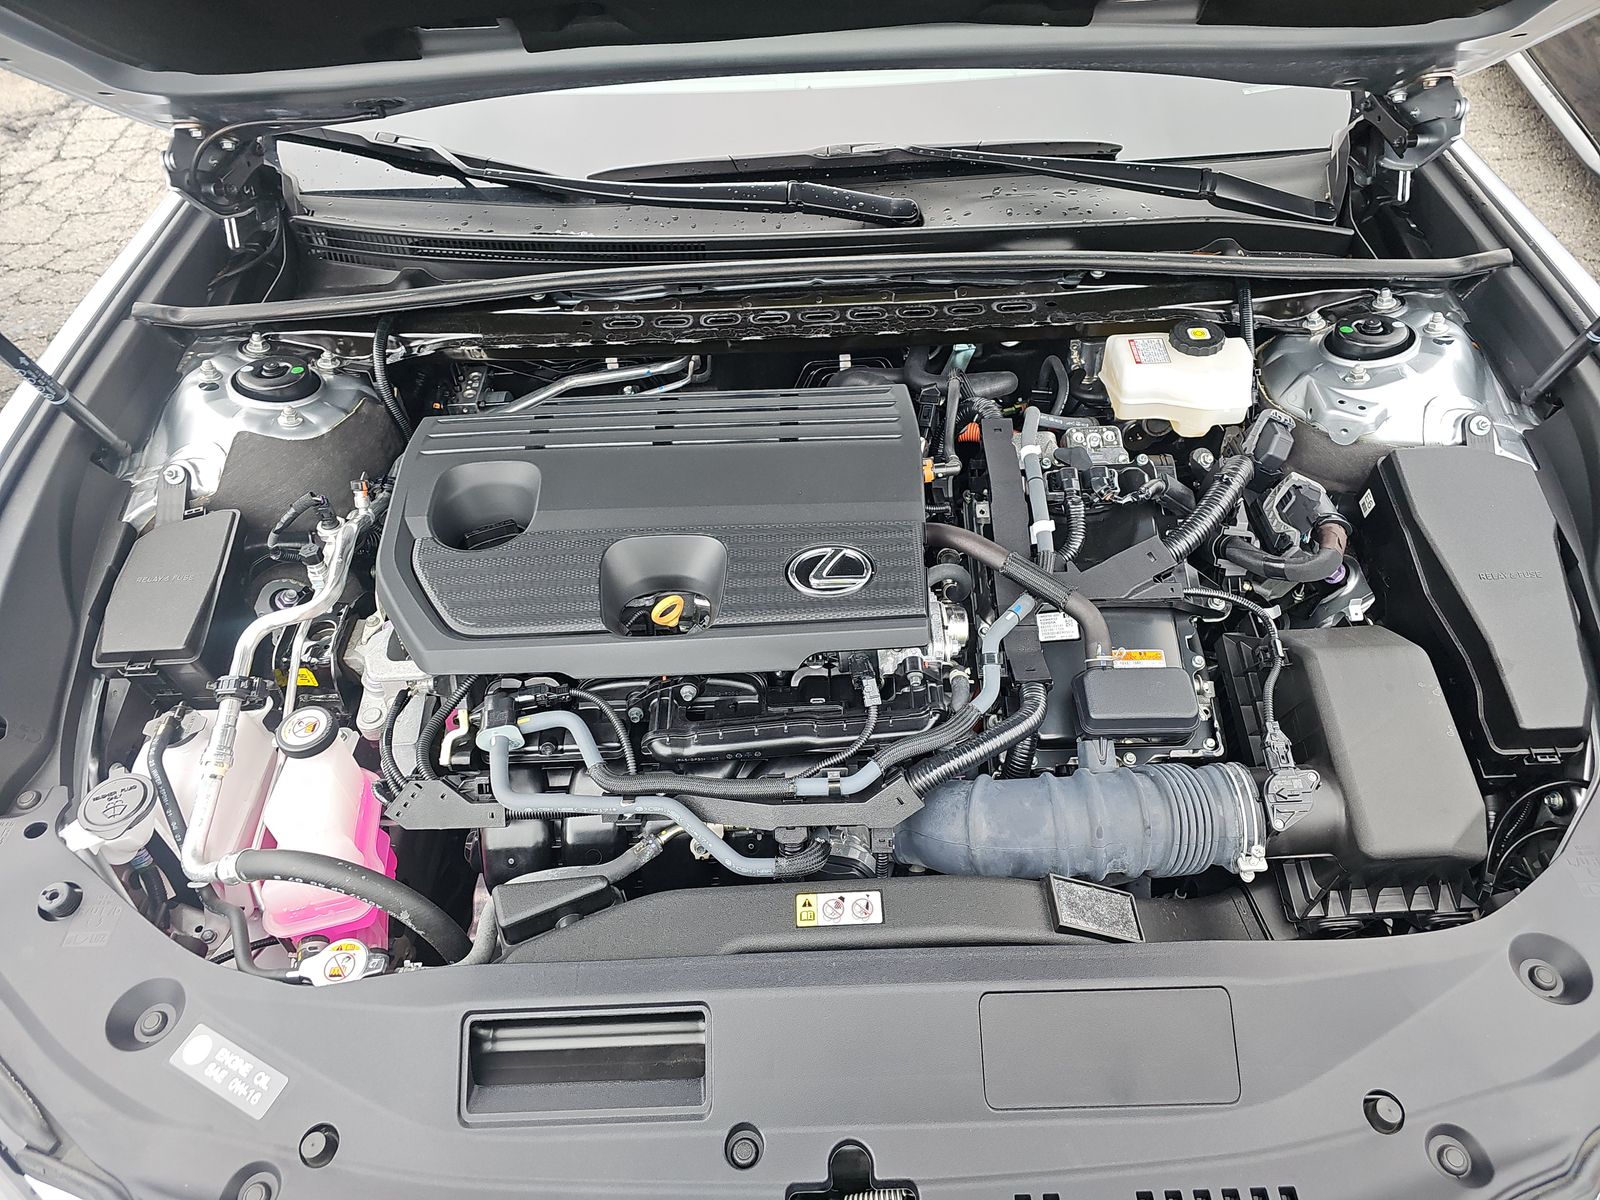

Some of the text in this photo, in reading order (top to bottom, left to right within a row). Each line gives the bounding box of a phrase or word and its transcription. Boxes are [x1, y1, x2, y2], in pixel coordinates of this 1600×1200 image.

[204, 1062, 229, 1085] SAE
[215, 1047, 271, 1091] ENGINE OIL
